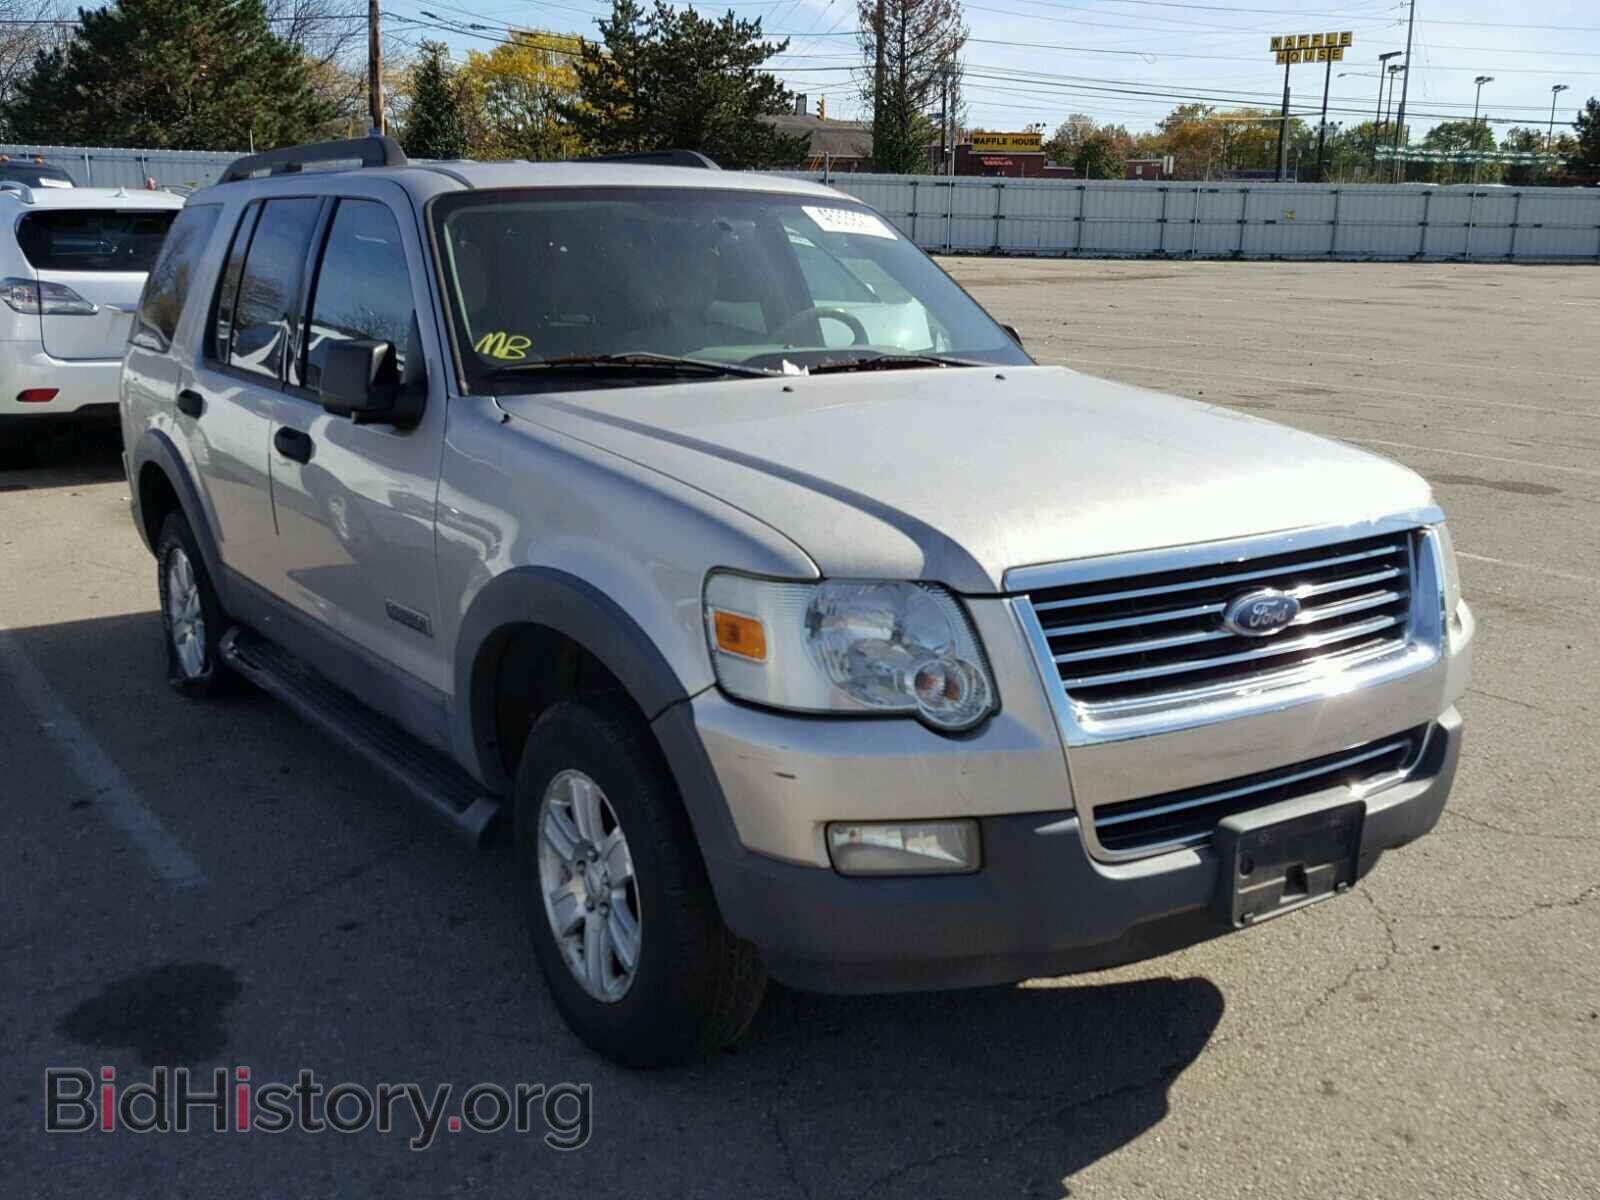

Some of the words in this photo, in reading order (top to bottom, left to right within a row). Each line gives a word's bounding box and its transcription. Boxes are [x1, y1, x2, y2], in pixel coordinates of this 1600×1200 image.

[1271, 32, 1350, 49] WAFFLE
[1278, 49, 1341, 62] HOUSE
[973, 137, 1008, 145] WAFFLE
[1012, 137, 1040, 146] HOUSE
[475, 331, 532, 359] MB
[1249, 599, 1289, 628] Ford
